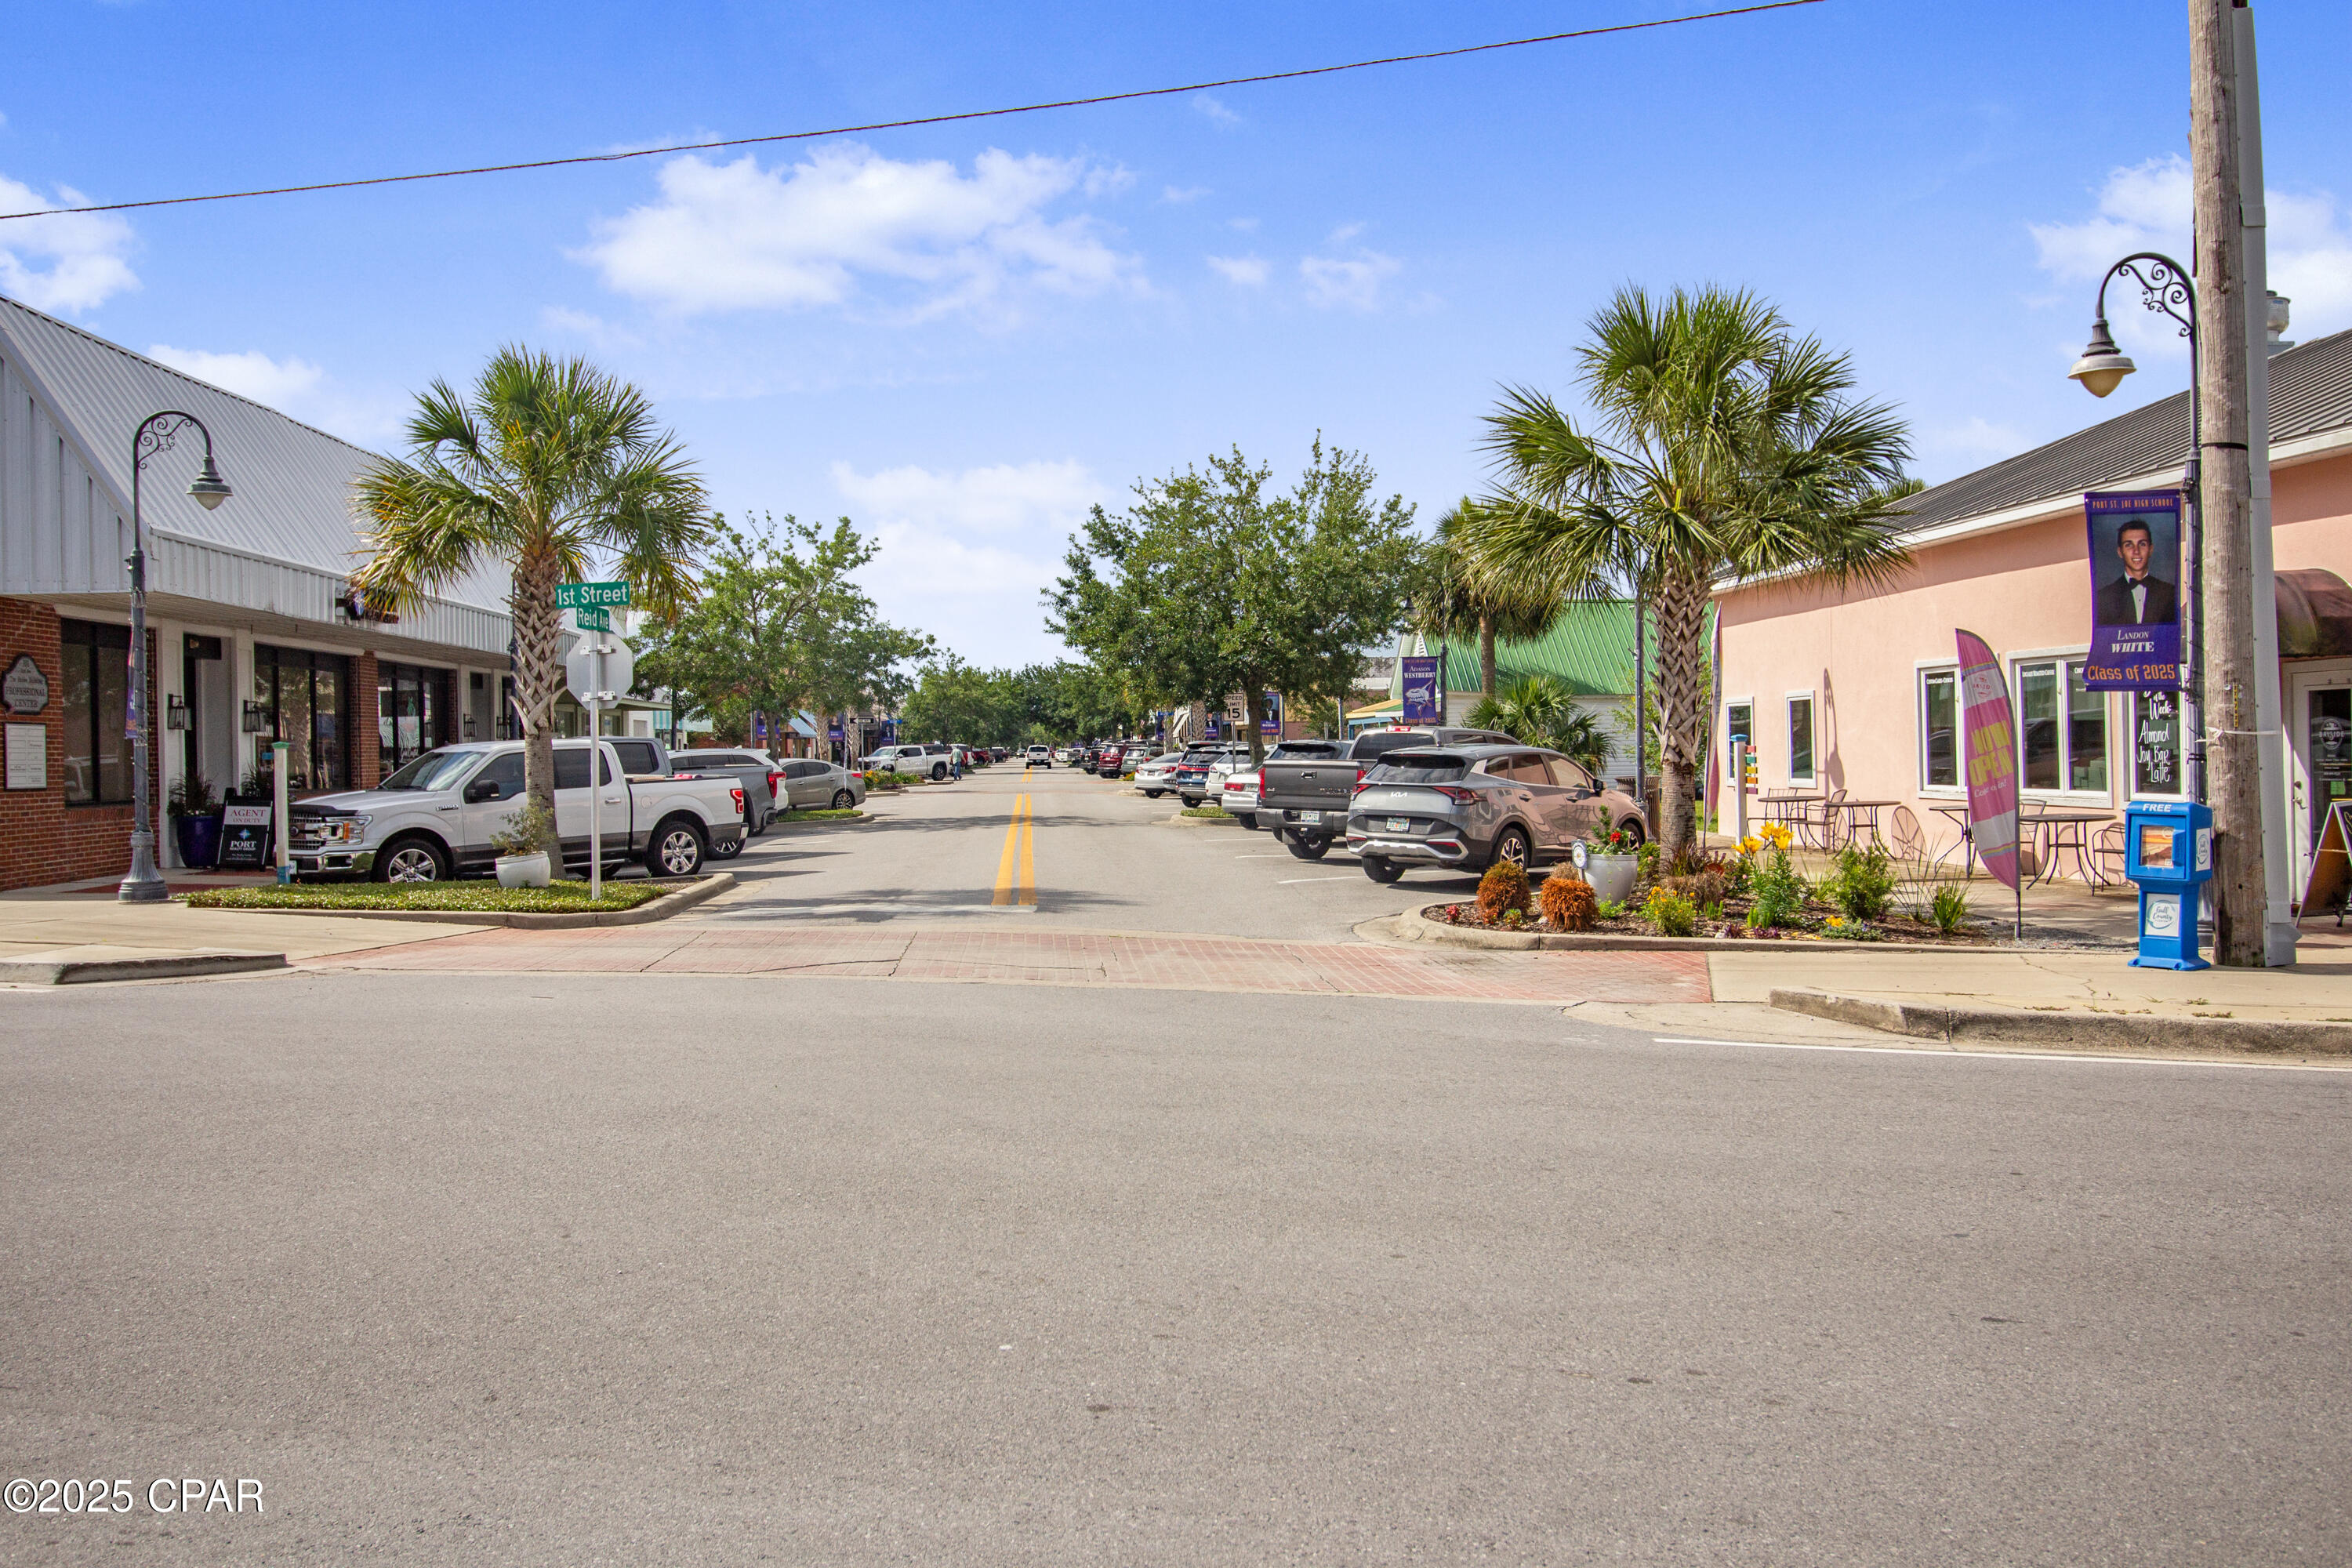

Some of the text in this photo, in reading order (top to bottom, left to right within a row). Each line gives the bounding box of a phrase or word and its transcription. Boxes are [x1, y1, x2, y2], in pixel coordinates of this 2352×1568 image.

[2092, 498, 2173, 509] PORT ST. JOE HIGH SCHOOL
[557, 585, 627, 605] 1st Street
[578, 608, 608, 629] Reid Ave
[2111, 641, 2154, 653] WHITE
[2088, 664, 2176, 682] Class of 2025
[5, 686, 45, 696] PROFESSIONAL
[14, 699, 38, 708] CENTER
[1227, 708, 1240, 719] 15
[1972, 720, 2010, 755] NOW
[2138, 720, 2169, 744] Almond
[2136, 746, 2151, 771] Joy
[1969, 747, 2013, 786] OPEN
[2151, 761, 2170, 783] Latte
[231, 808, 267, 817] AGENT
[2143, 803, 2172, 812] FREE
[2153, 912, 2172, 921] County
